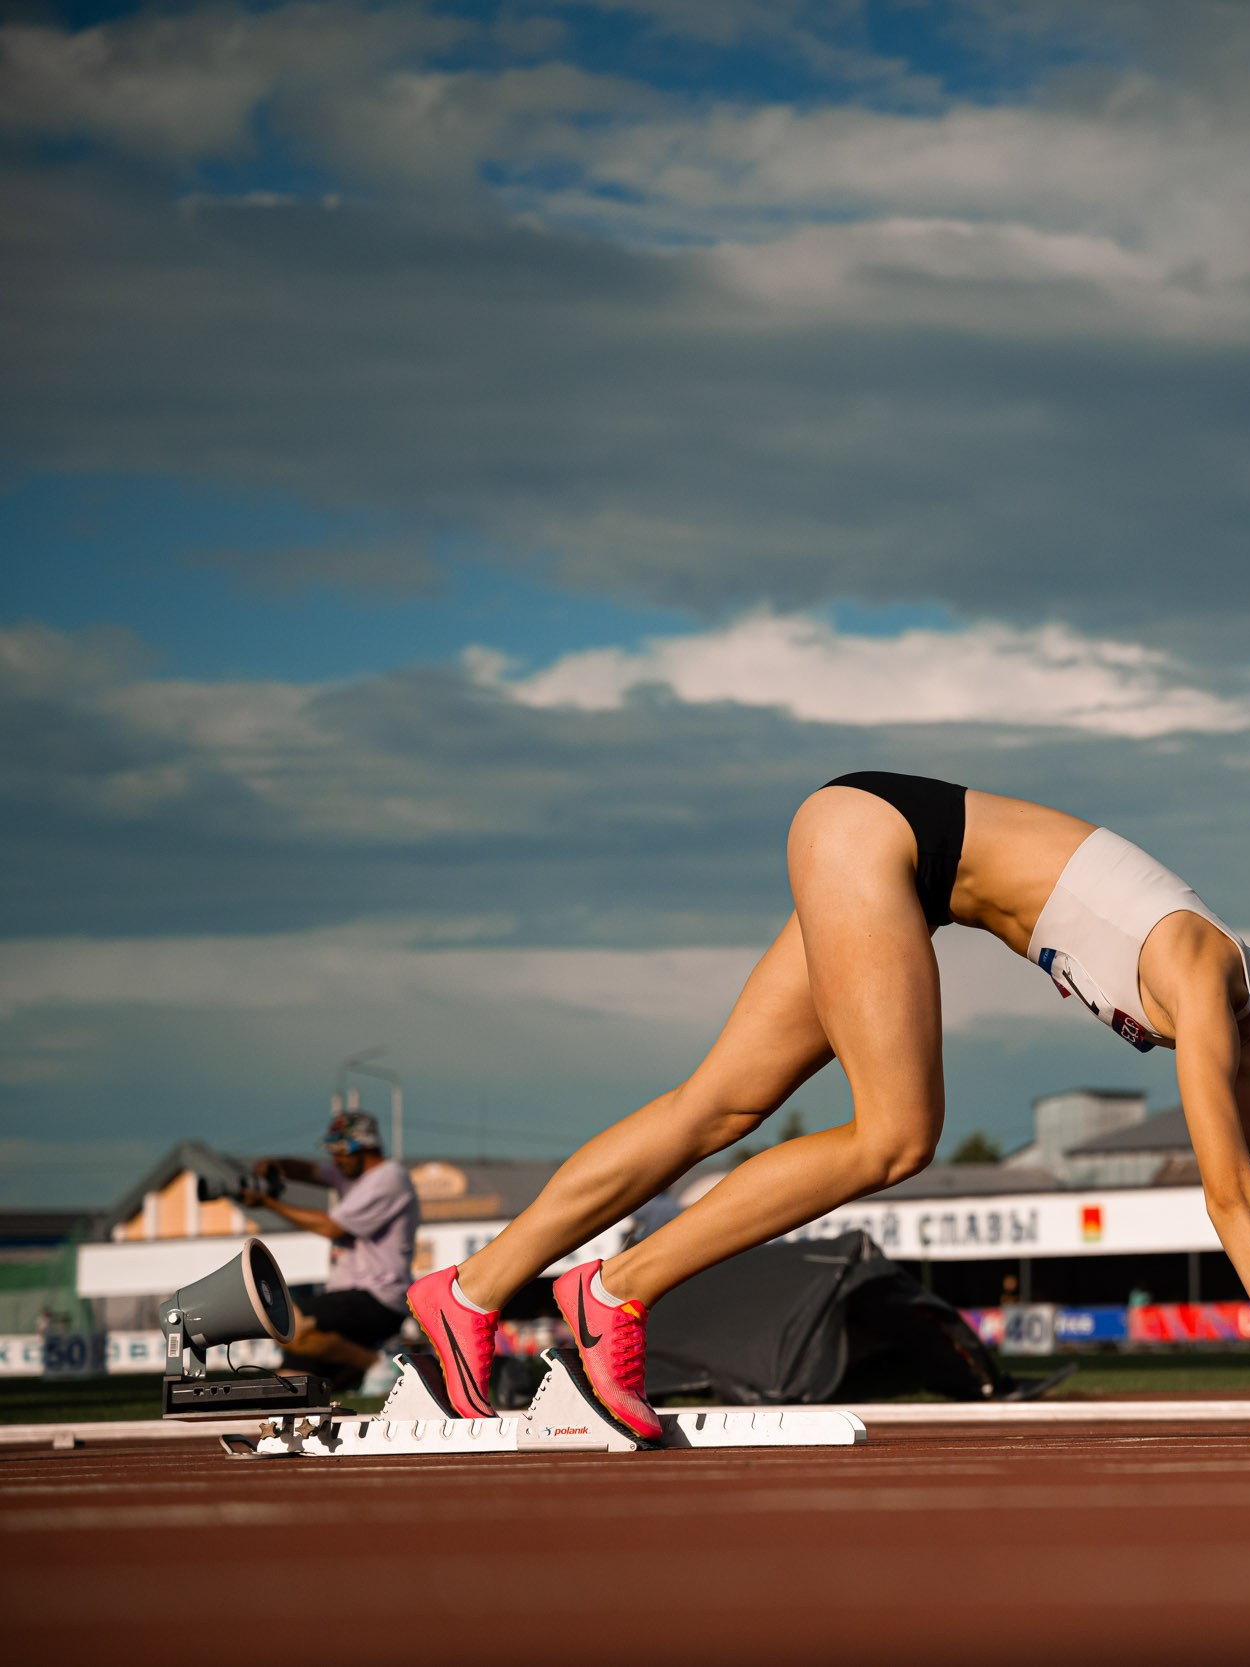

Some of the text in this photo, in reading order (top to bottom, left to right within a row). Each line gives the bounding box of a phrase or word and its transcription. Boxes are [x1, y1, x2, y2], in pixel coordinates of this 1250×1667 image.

[918, 1207, 1038, 1246] СЛАВЫ
[1005, 1310, 1046, 1342] 40
[47, 1335, 86, 1368] 50
[554, 1426, 589, 1436] polanik
